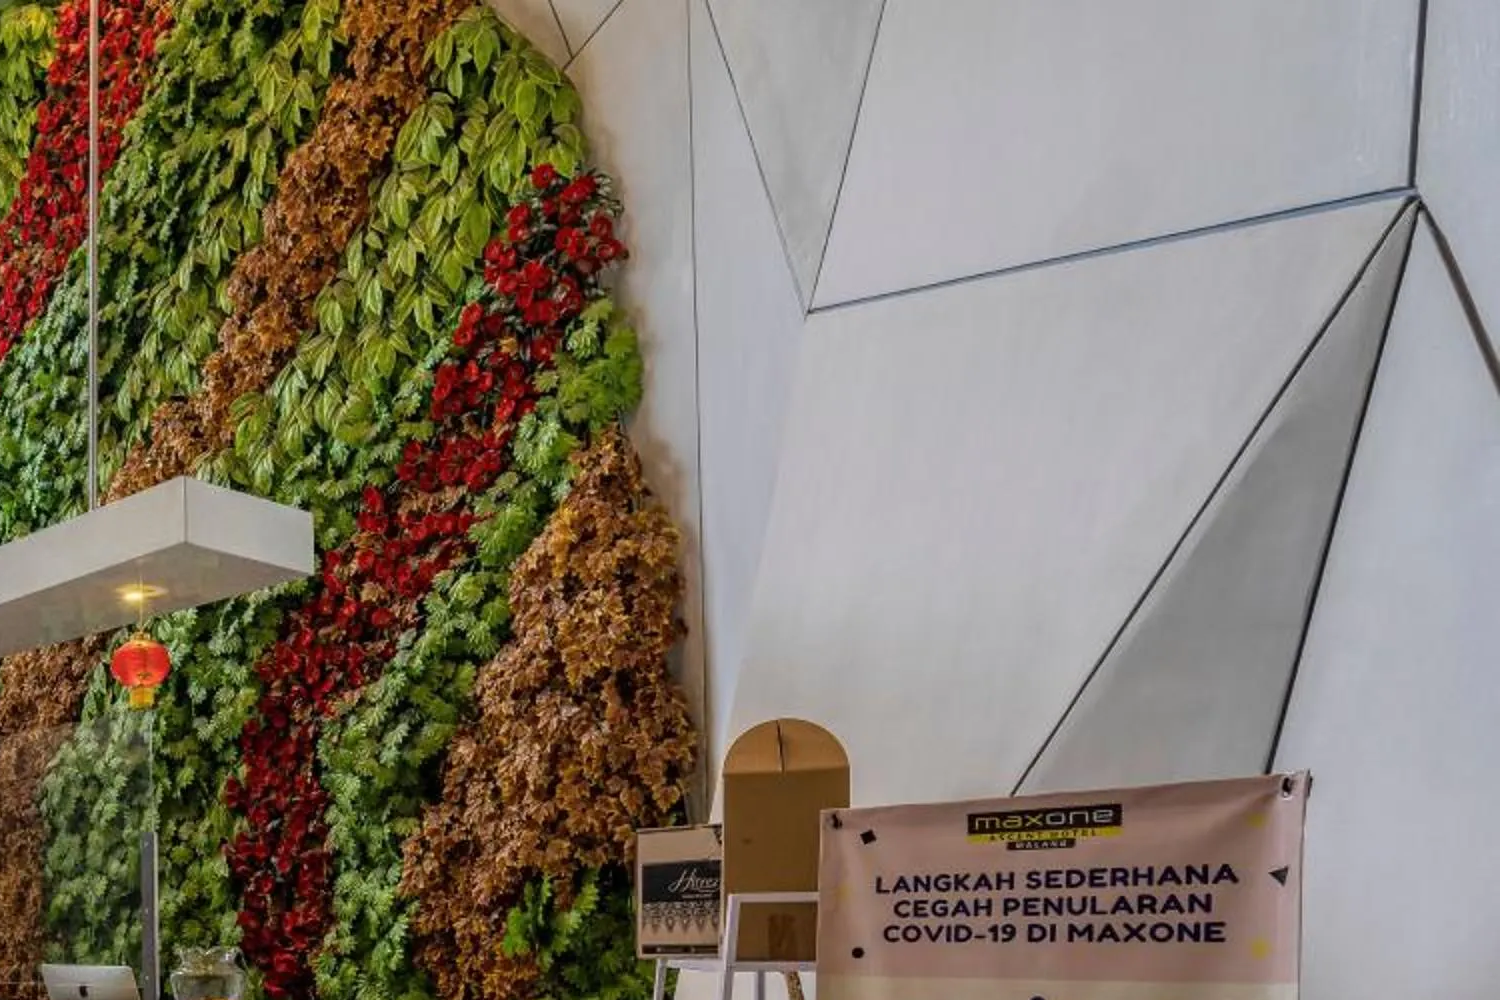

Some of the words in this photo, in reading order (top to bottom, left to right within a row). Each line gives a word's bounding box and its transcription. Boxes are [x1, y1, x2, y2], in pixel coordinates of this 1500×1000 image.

[975, 808, 1114, 831] maxone
[876, 871, 1015, 895] LANGKAH
[1026, 864, 1239, 889] SEDERHANA
[894, 899, 993, 919] CEGAH
[1003, 894, 1213, 916] PENULARAN
[883, 922, 1016, 943] COVID-19
[1027, 923, 1057, 943] DI
[1068, 921, 1226, 943] MAXONE
